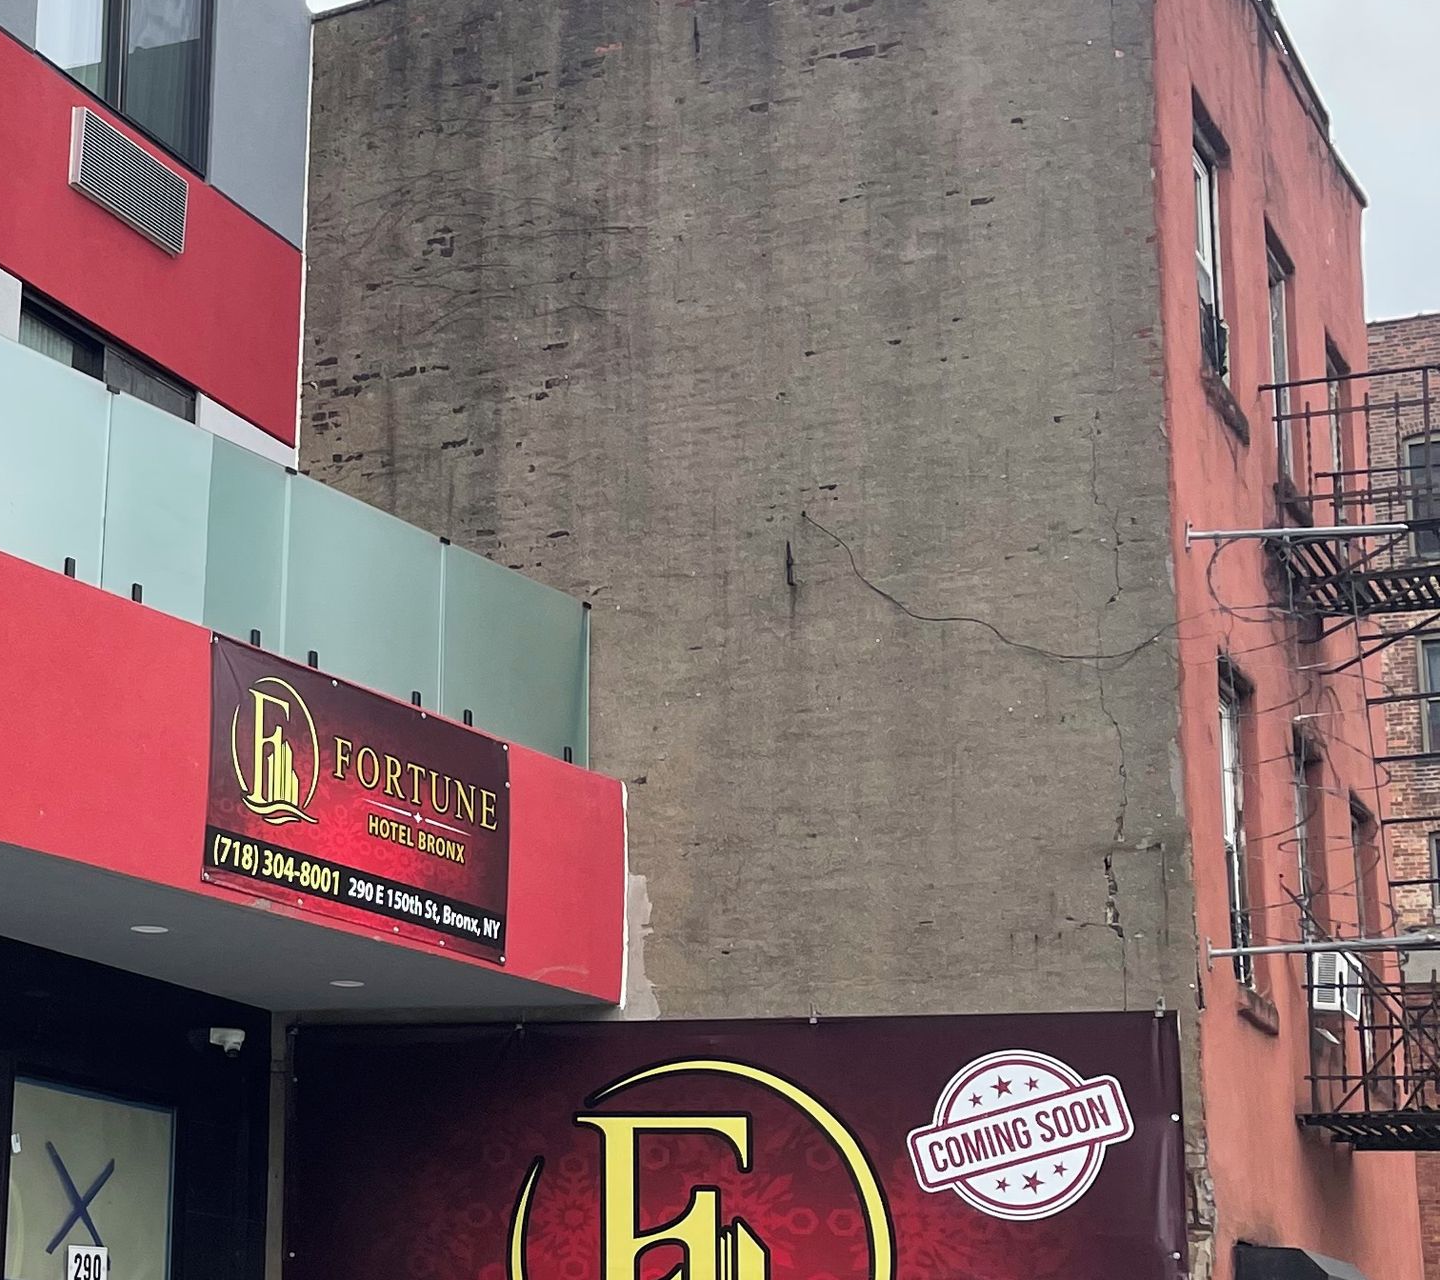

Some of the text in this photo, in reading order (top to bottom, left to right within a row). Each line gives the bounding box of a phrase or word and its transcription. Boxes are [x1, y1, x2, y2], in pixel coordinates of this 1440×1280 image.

[333, 736, 498, 831] FORTUNE
[213, 833, 340, 896] (718) 304-8001
[368, 814, 465, 864] HOTEL BRONX
[348, 877, 501, 940] 290 E 150th St, Bronx, NY
[927, 1094, 1112, 1173] COMING SOON
